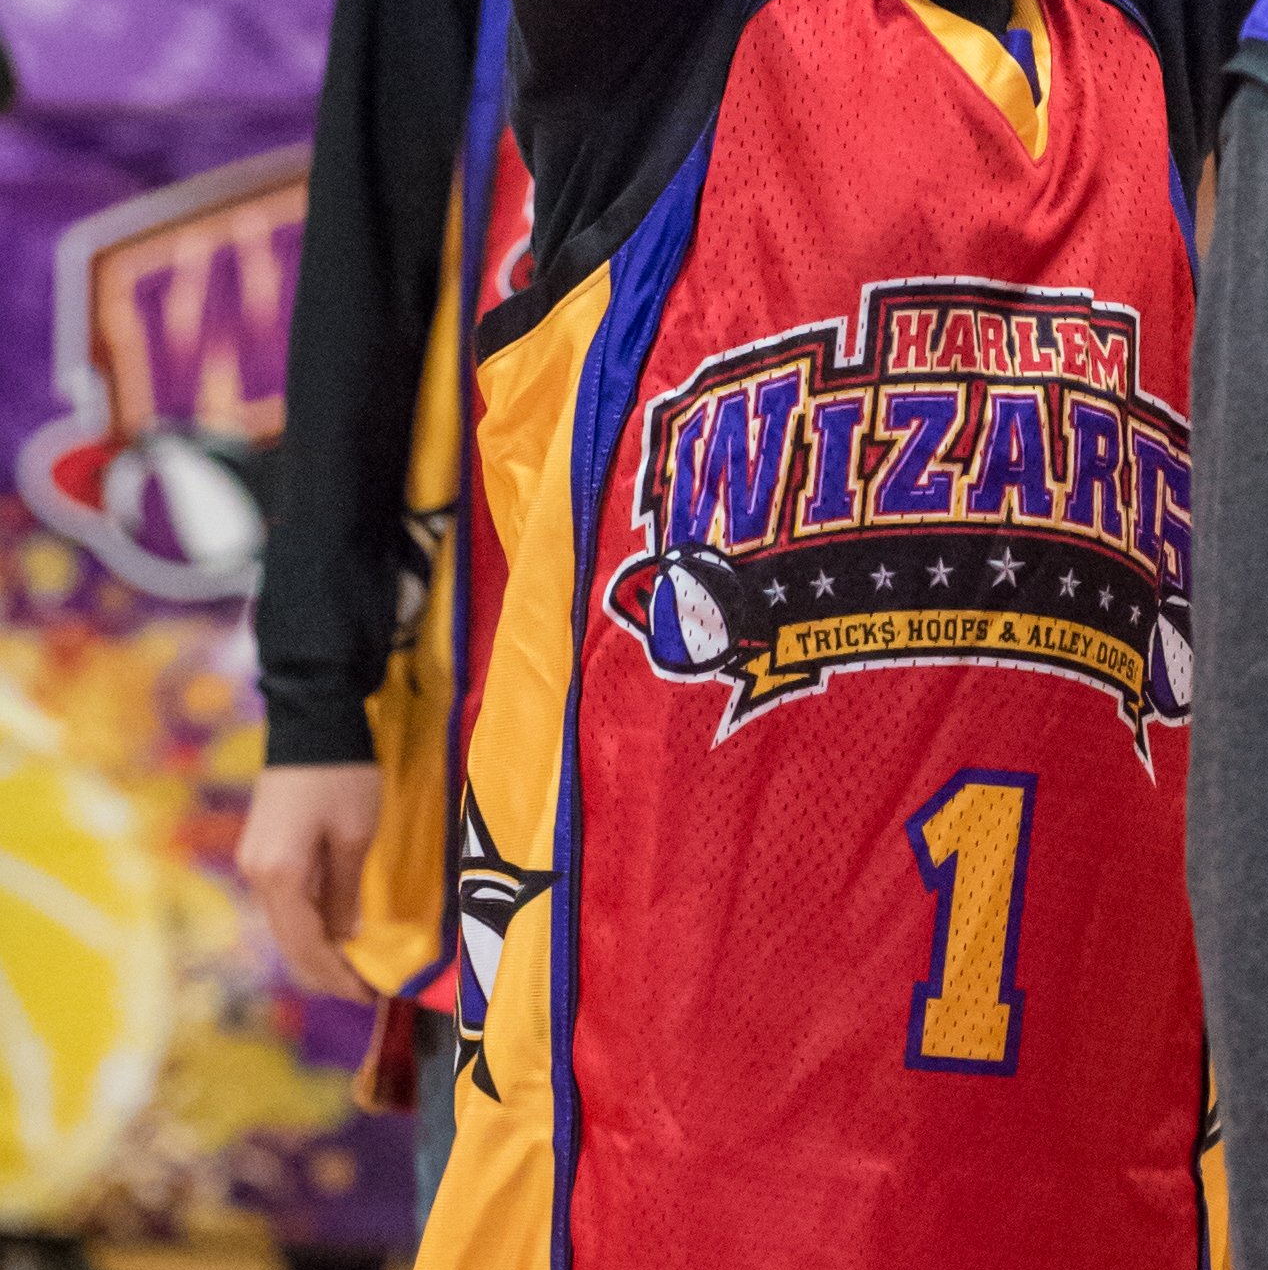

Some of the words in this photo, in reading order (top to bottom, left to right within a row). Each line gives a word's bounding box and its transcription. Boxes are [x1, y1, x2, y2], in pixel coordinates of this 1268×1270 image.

[888, 308, 1128, 397] HARLEM
[796, 615, 896, 657] TRICKS
[908, 618, 990, 643] HOOPS
[999, 620, 1018, 642] &
[1028, 624, 1093, 658] ALLEY
[904, 767, 1039, 1077] 1
